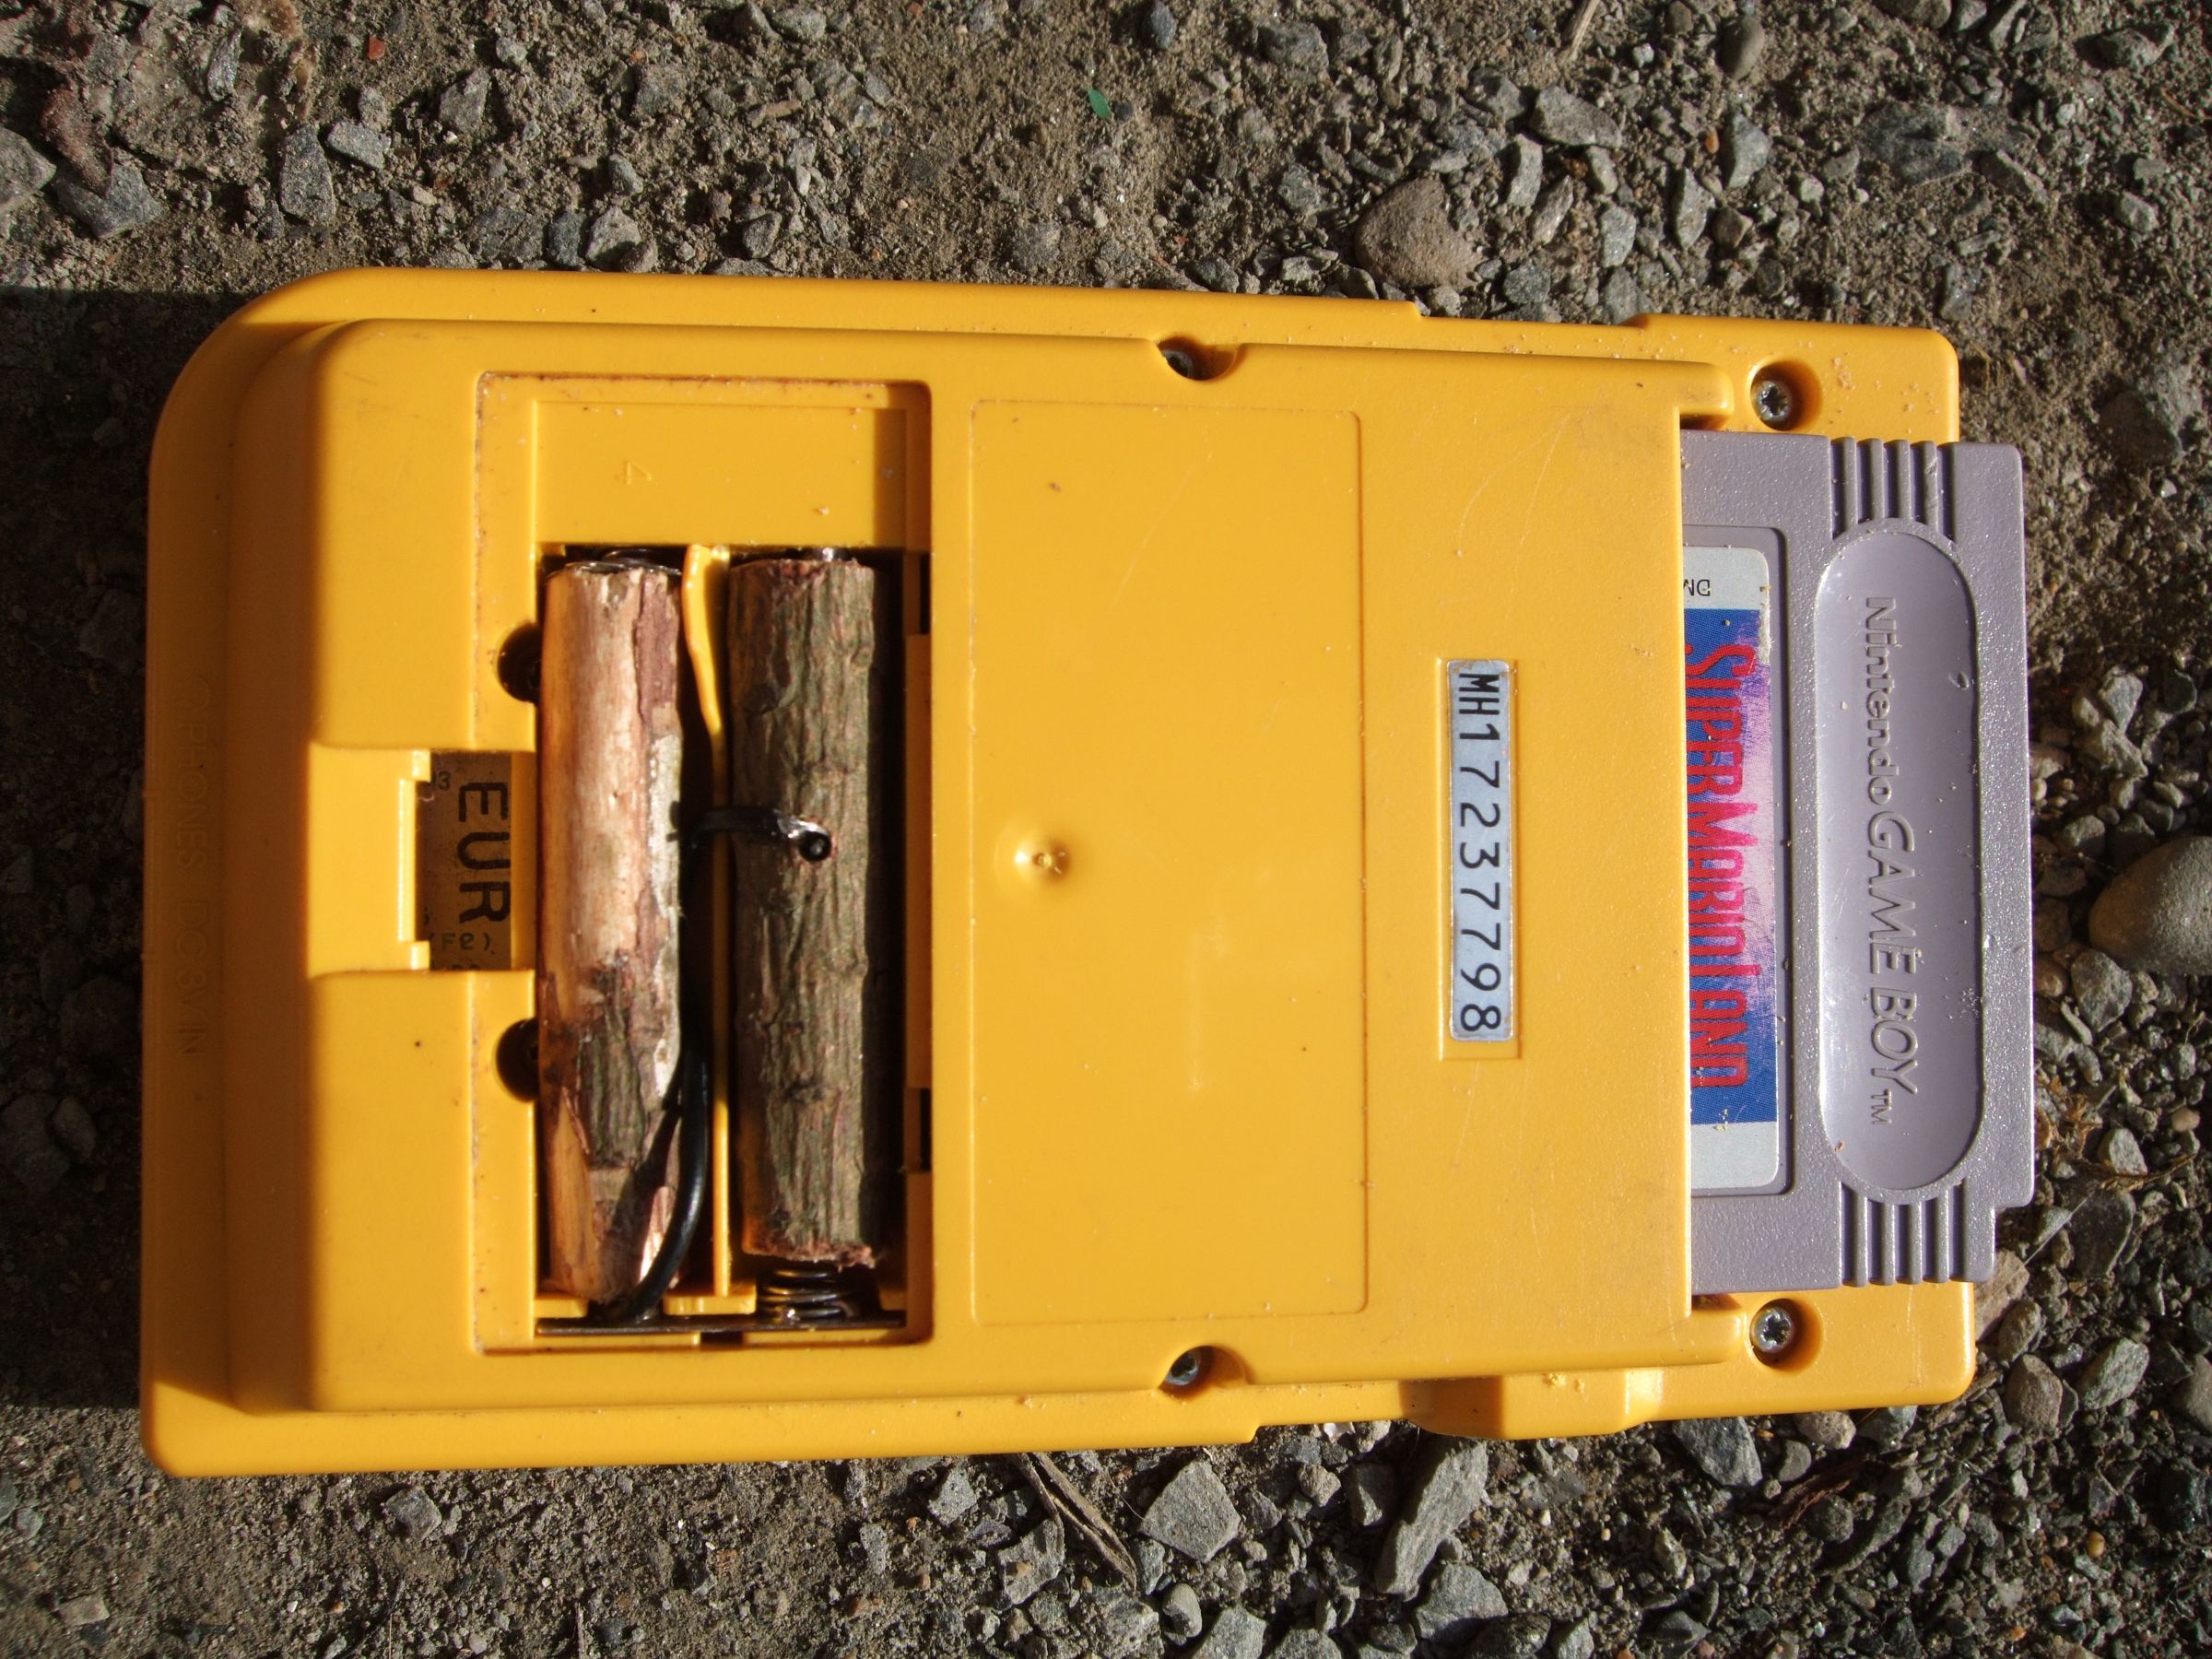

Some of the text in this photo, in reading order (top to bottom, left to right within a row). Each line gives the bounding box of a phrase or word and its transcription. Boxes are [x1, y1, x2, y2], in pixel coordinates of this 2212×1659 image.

[176, 723, 207, 868] PHONES
[458, 782, 511, 924] EUR
[1458, 672, 1501, 1033] MH17237798
[1865, 597, 1918, 1125] Nintendo GAME BOY TM
